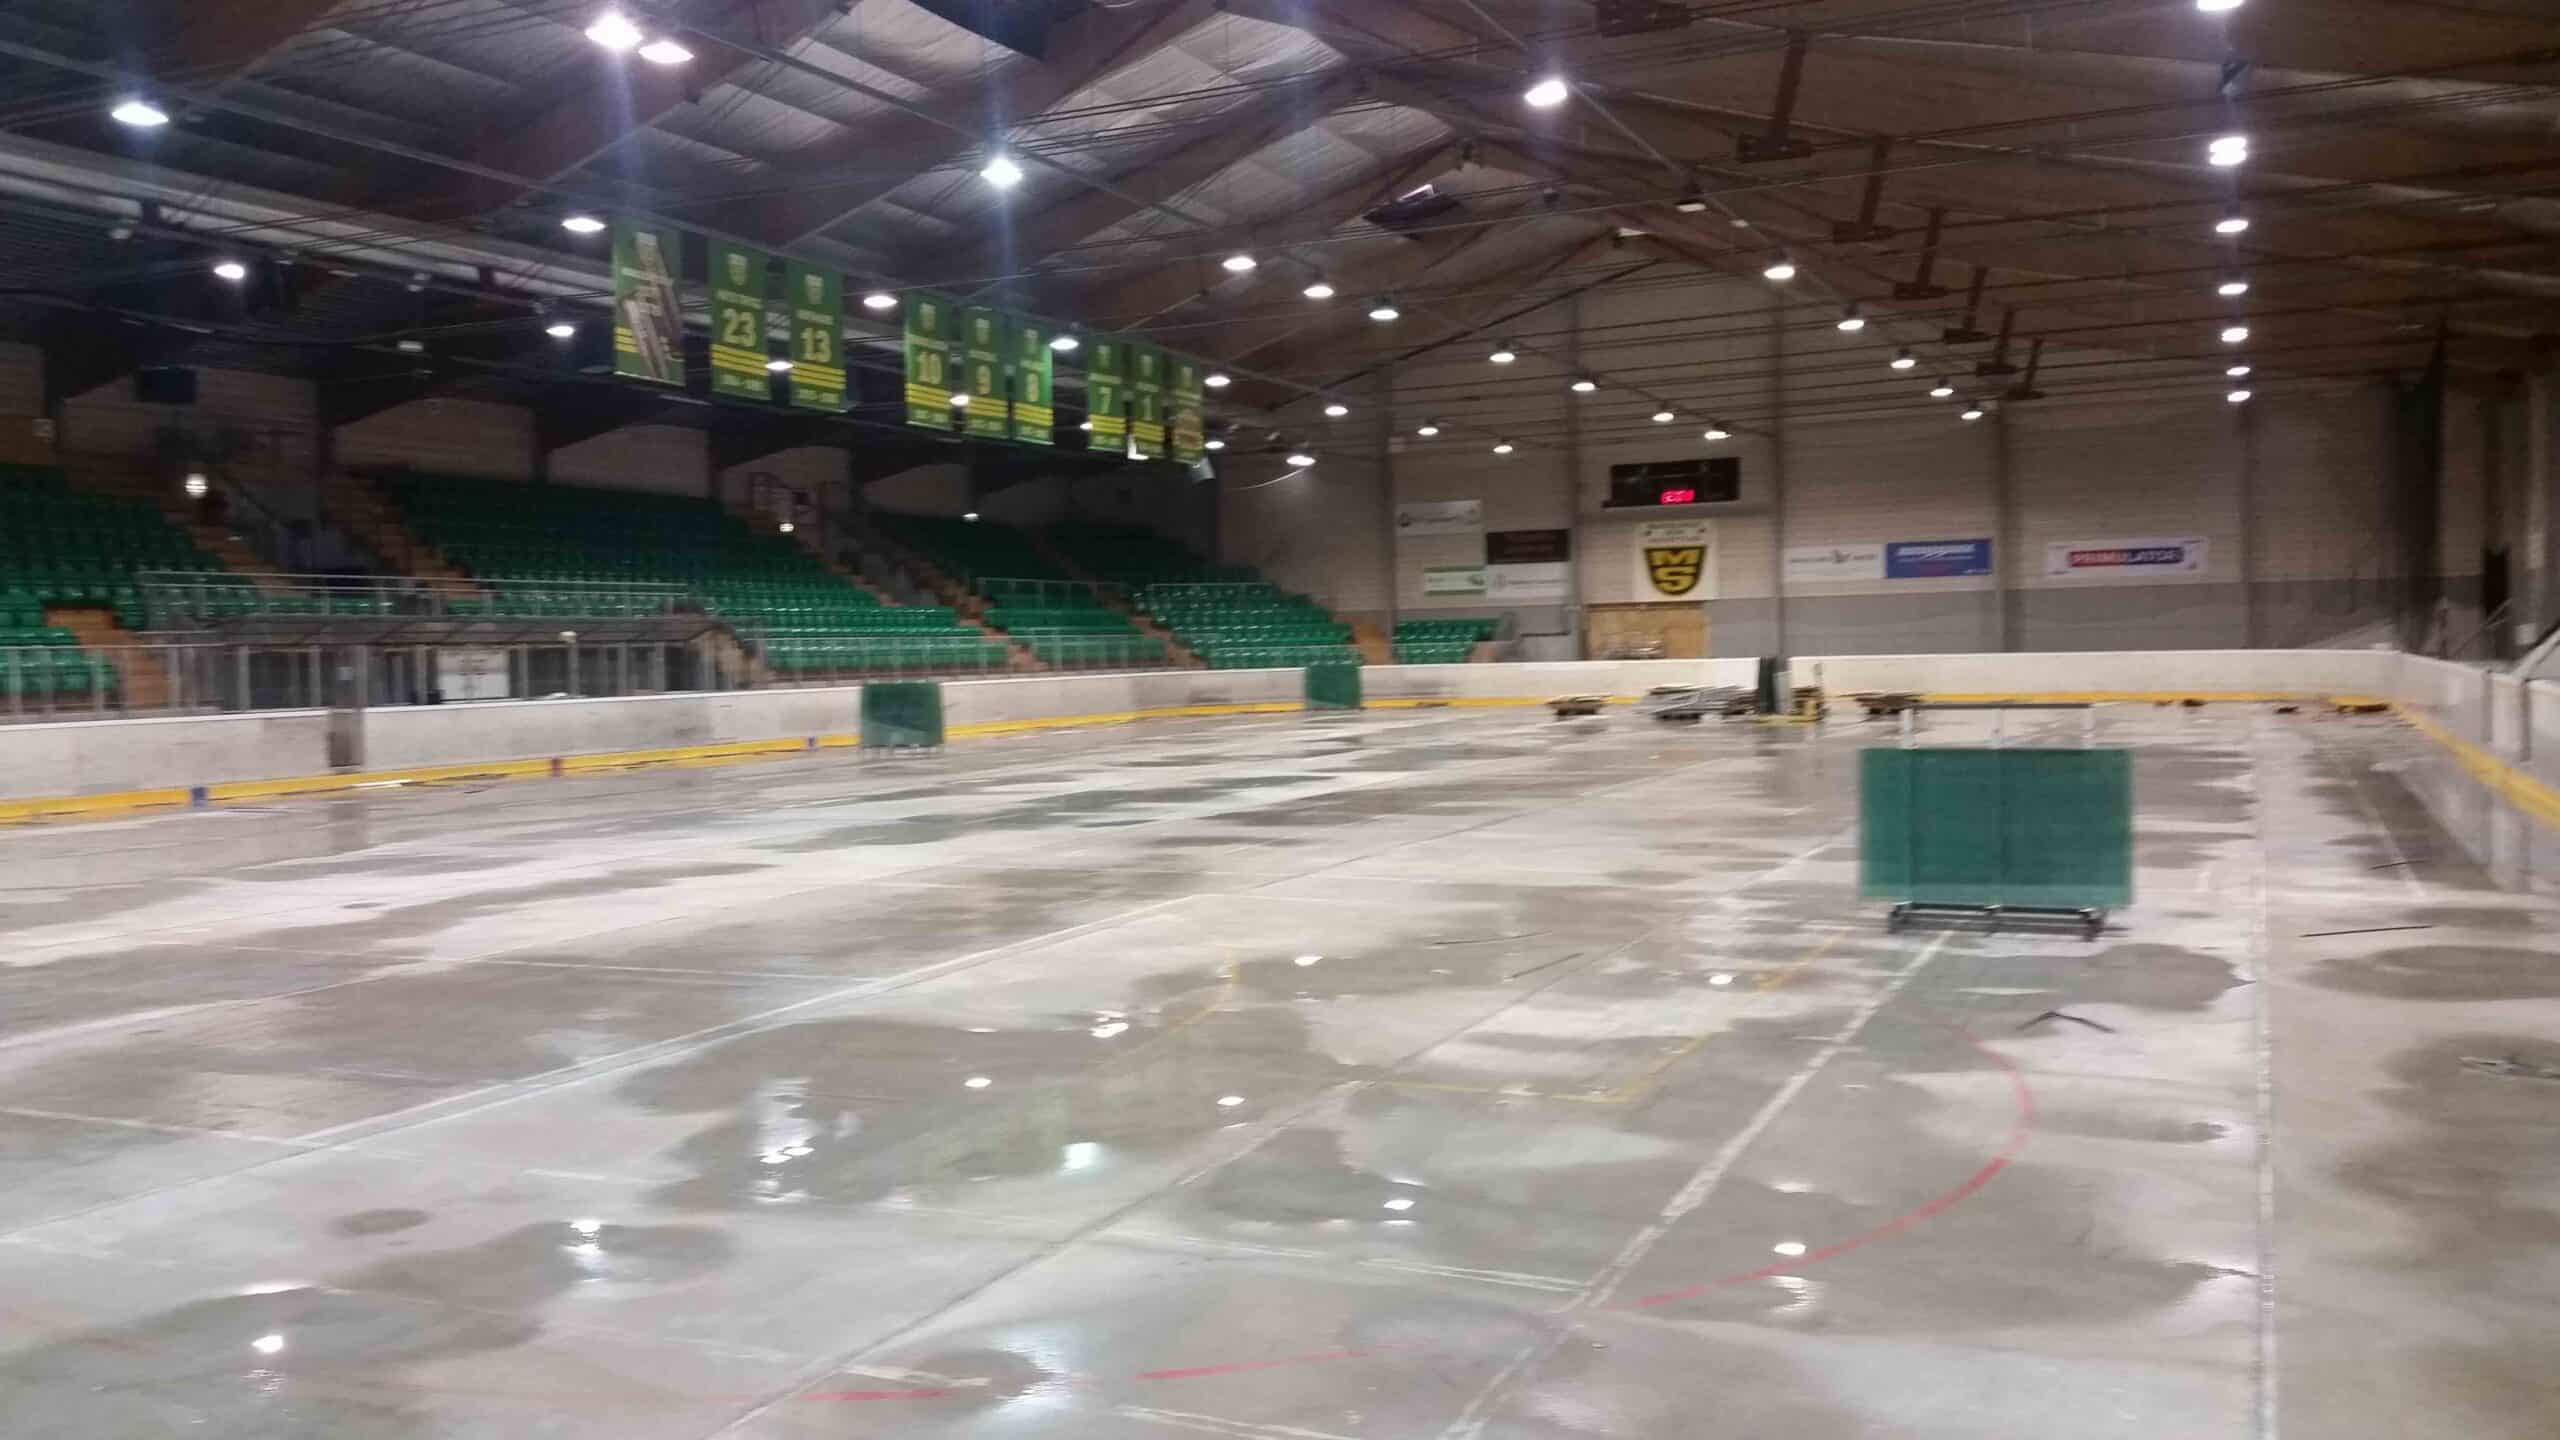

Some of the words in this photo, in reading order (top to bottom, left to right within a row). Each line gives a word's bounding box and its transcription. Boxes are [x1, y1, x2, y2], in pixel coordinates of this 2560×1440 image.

[722, 308, 757, 347] 23
[800, 328, 832, 362] 13
[918, 352, 942, 384] 10
[1098, 386, 1112, 414] 7
[1650, 549, 1699, 565] M
[1653, 566, 1697, 593] S
